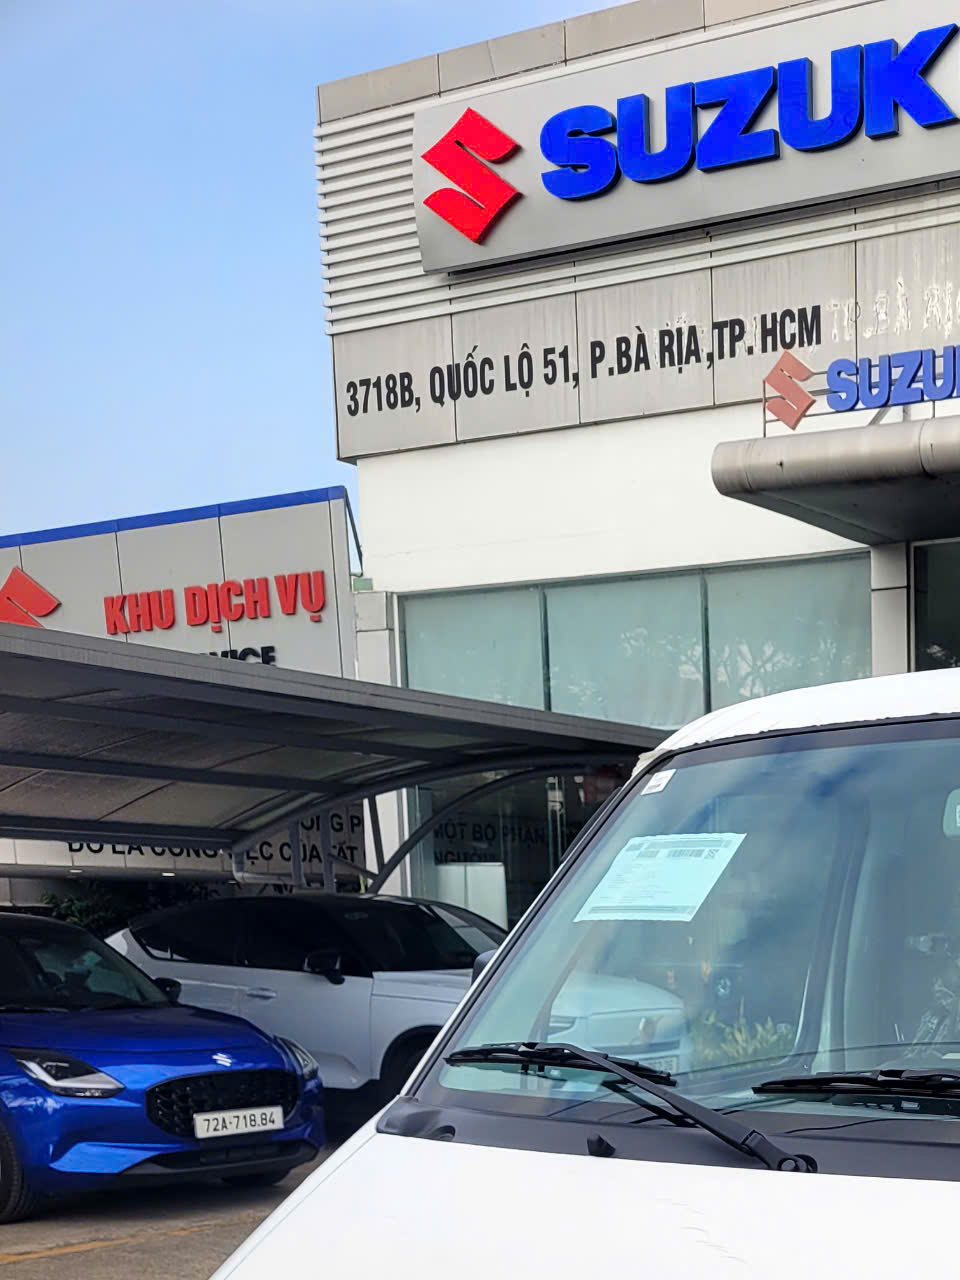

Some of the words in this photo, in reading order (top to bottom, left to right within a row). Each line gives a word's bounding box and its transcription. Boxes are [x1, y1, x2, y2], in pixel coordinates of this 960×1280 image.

[346, 371, 421, 417] 3718B,
[429, 345, 495, 407] QUỐC
[503, 342, 534, 398] LỘ
[543, 345, 580, 390] 51,
[103, 589, 175, 635] KHU
[184, 577, 271, 633] DỊCH
[274, 570, 326, 622] VỤ
[203, 1111, 275, 1133] 72A-718.84
